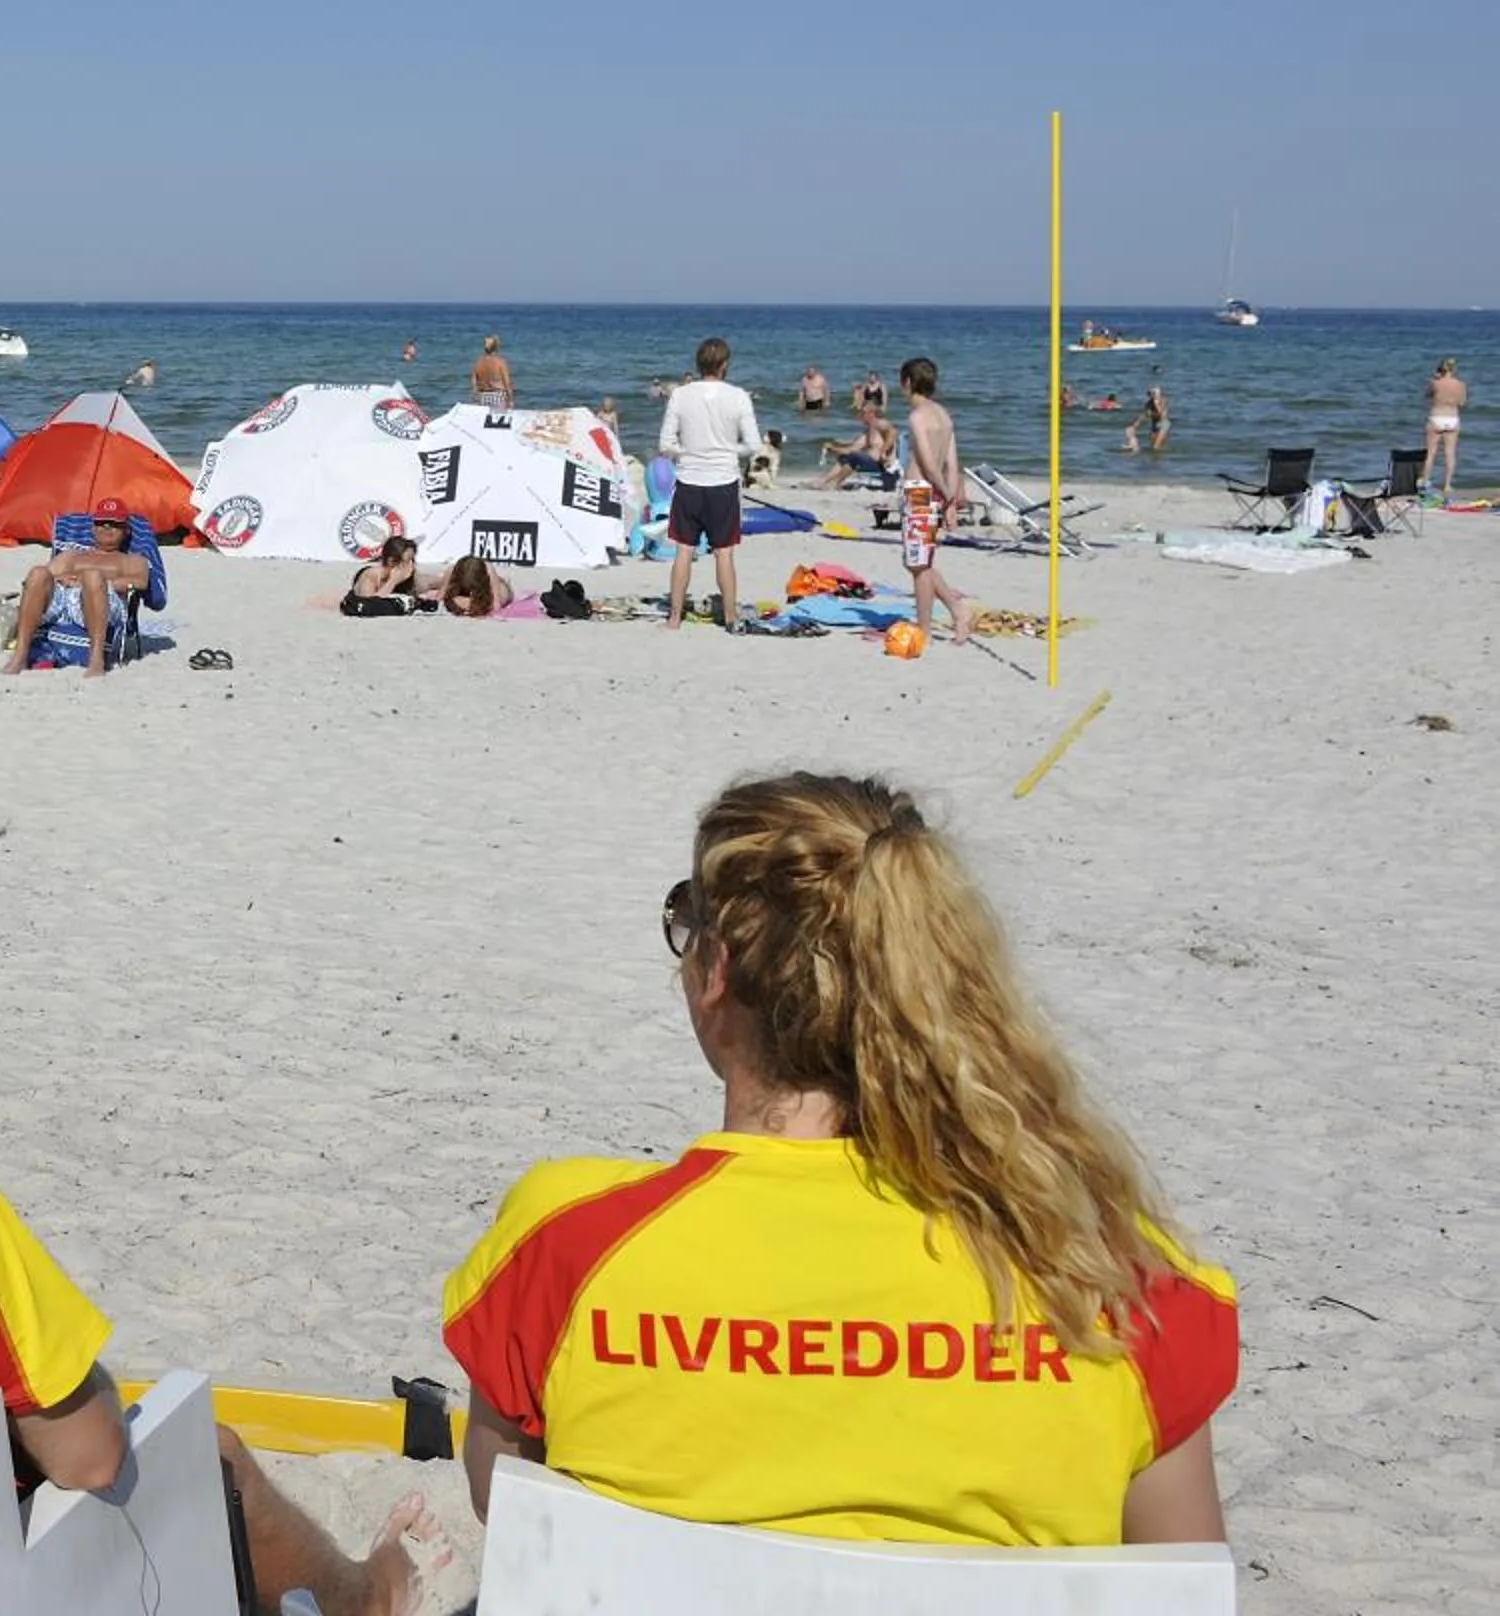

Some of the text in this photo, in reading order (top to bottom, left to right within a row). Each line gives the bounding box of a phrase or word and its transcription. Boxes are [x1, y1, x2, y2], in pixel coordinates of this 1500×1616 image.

[425, 450, 451, 500] FABIA
[572, 467, 601, 512] FABI
[474, 531, 534, 561] FABIA
[591, 1308, 1072, 1383] LIVREDDER
